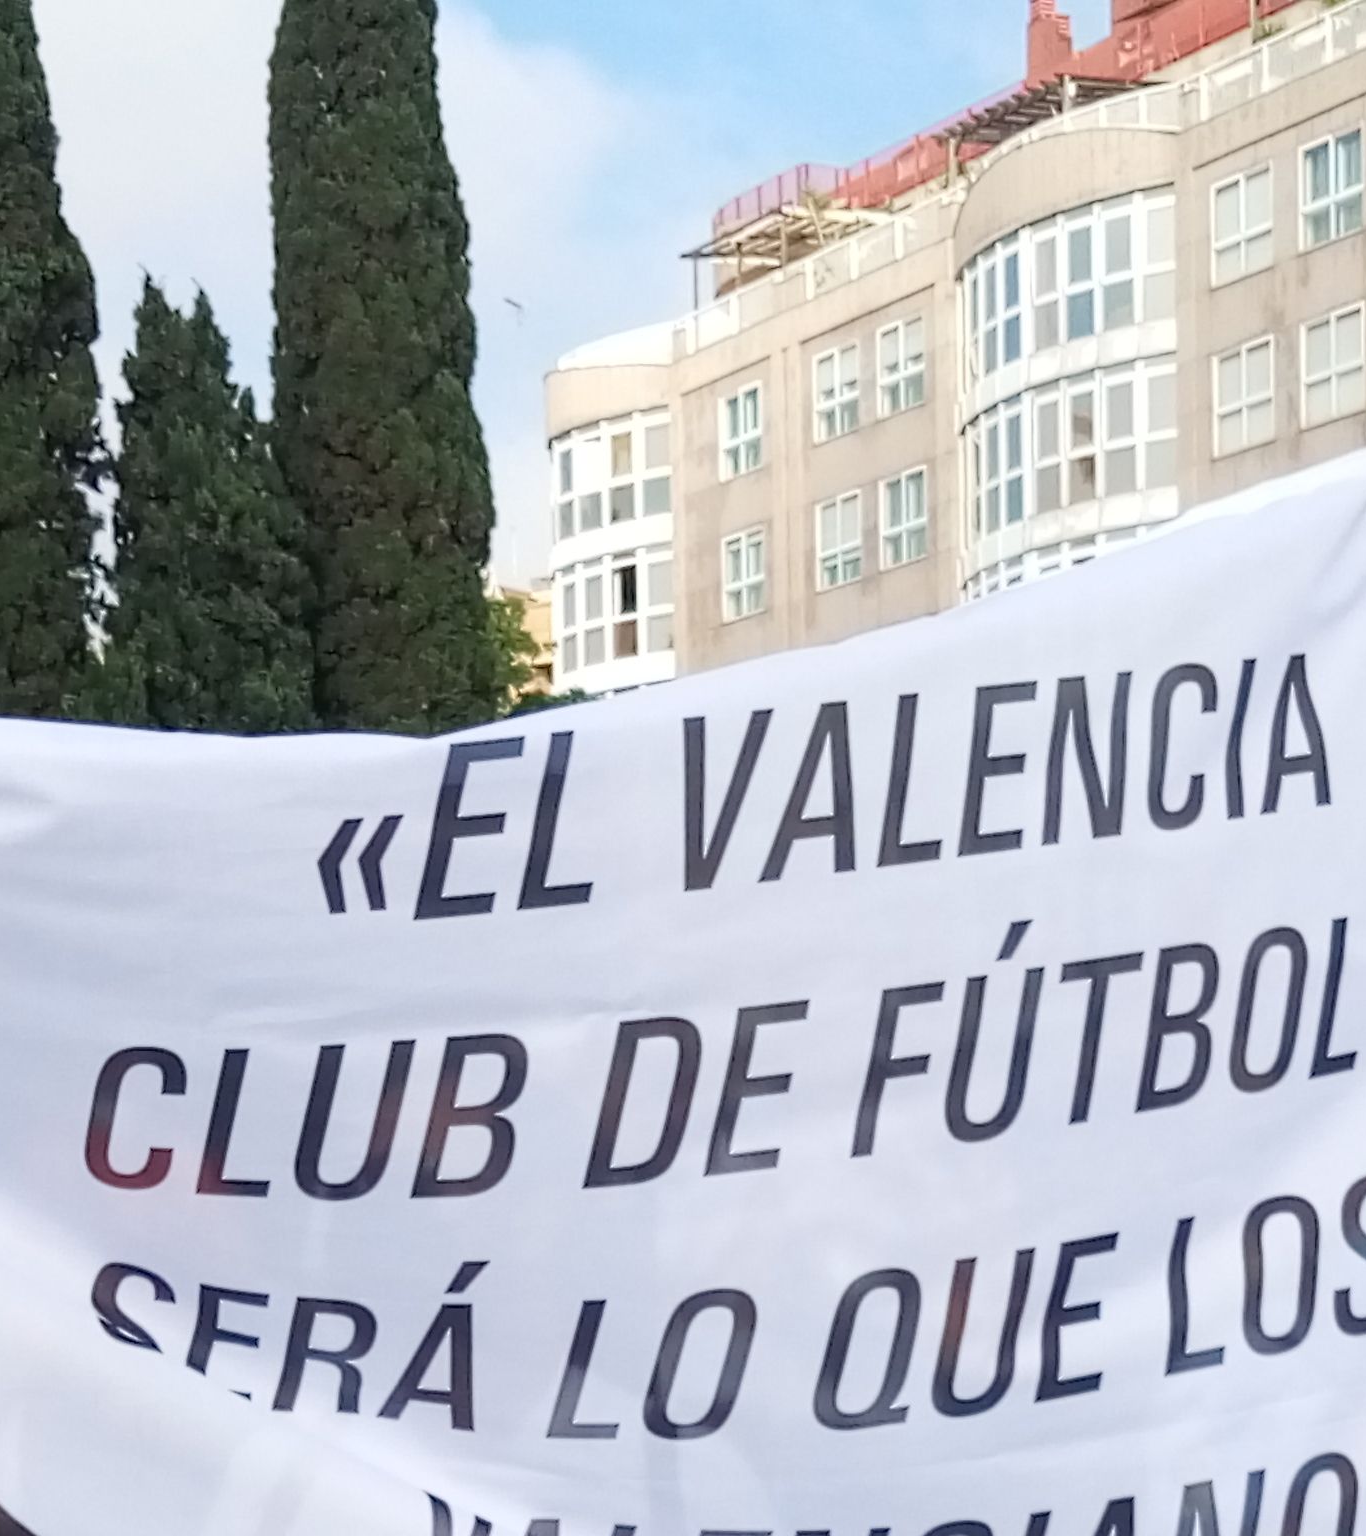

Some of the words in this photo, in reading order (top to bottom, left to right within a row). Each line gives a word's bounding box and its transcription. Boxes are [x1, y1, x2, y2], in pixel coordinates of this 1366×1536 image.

[315, 730, 594, 921] «EL
[682, 652, 1332, 892] VALENCIA
[84, 1033, 529, 1201] CLUB
[581, 999, 810, 1190] DE
[850, 916, 1358, 1158] FÚTBOL
[90, 1260, 491, 1432] SERÁ
[546, 1288, 758, 1441] LO
[813, 1231, 1120, 1431] QUE
